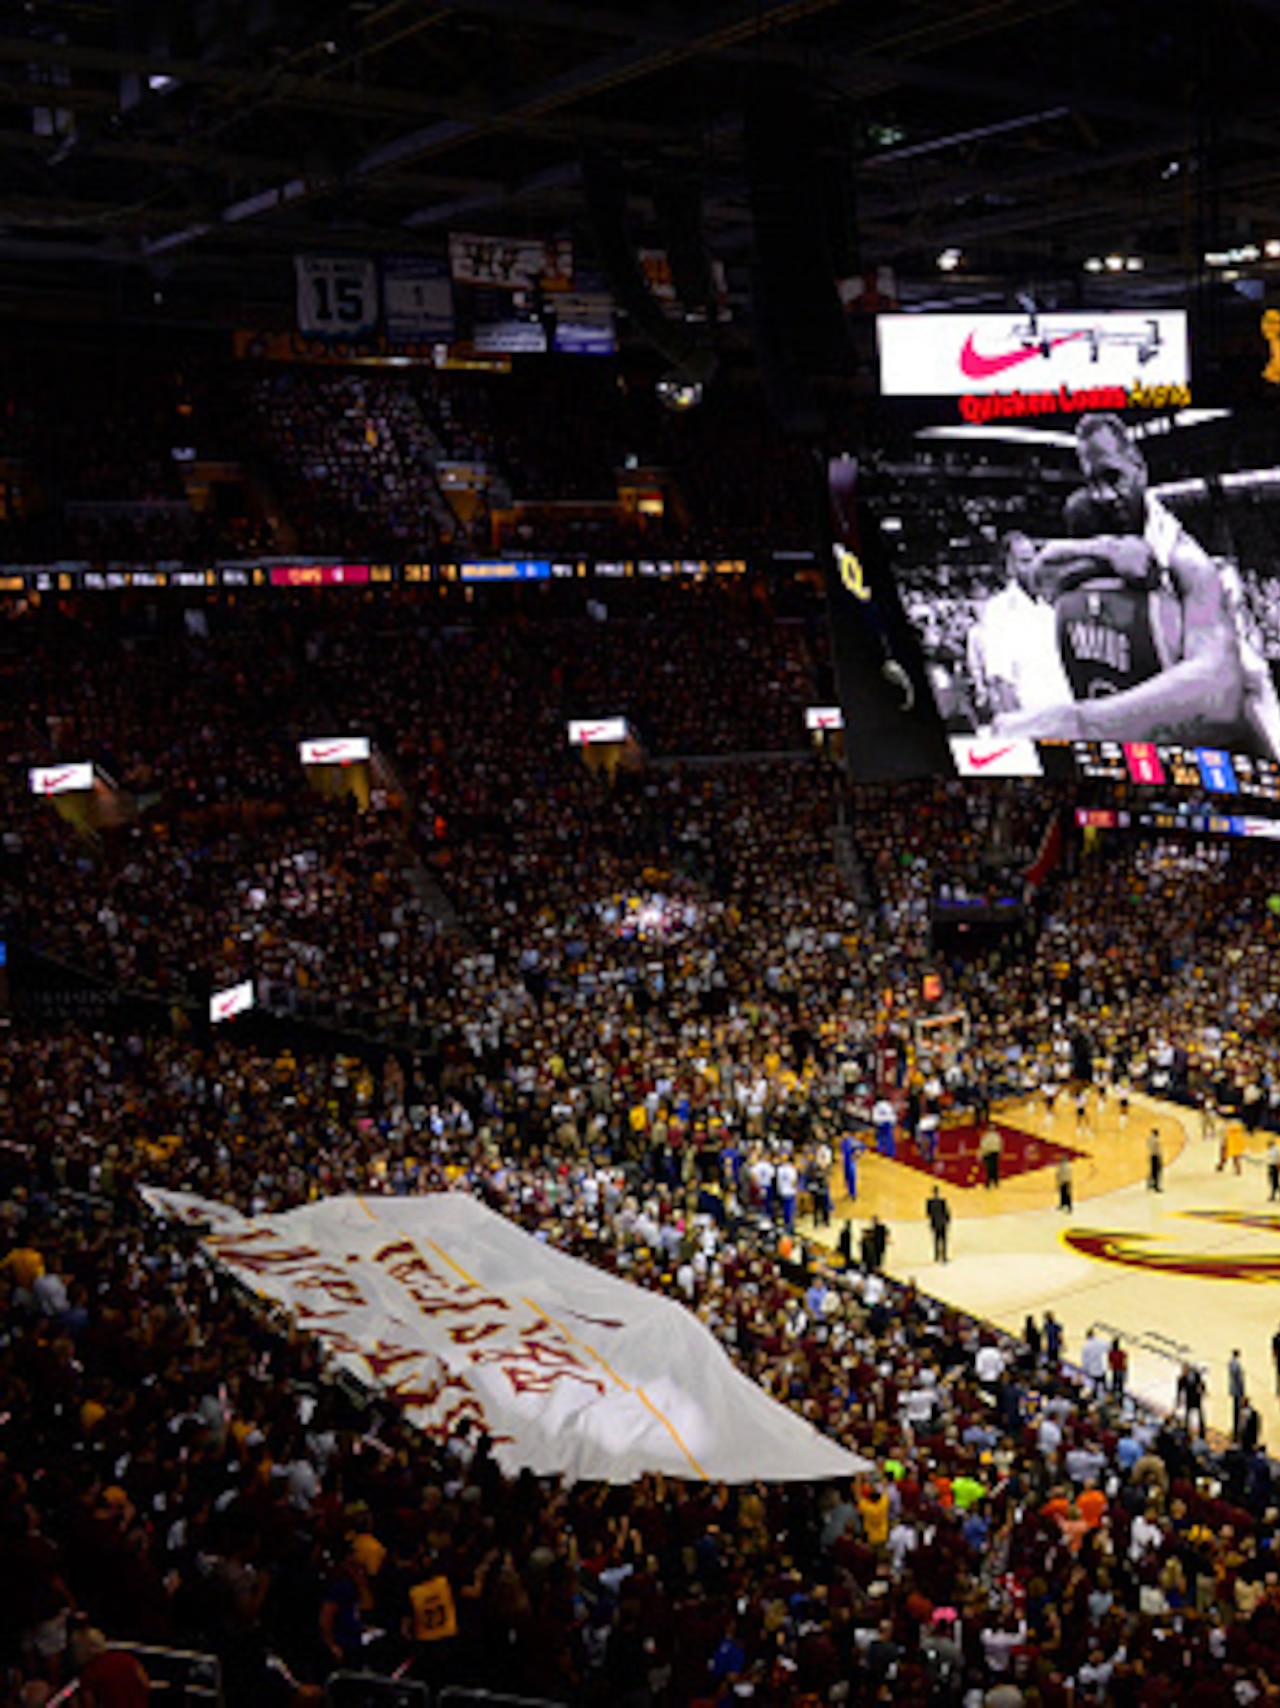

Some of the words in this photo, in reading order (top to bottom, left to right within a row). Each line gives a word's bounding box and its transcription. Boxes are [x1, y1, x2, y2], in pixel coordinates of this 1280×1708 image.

[313, 278, 363, 320] 15
[958, 389, 1056, 424] Quicken
[1058, 383, 1127, 413] Loans
[1128, 378, 1192, 408] Arena
